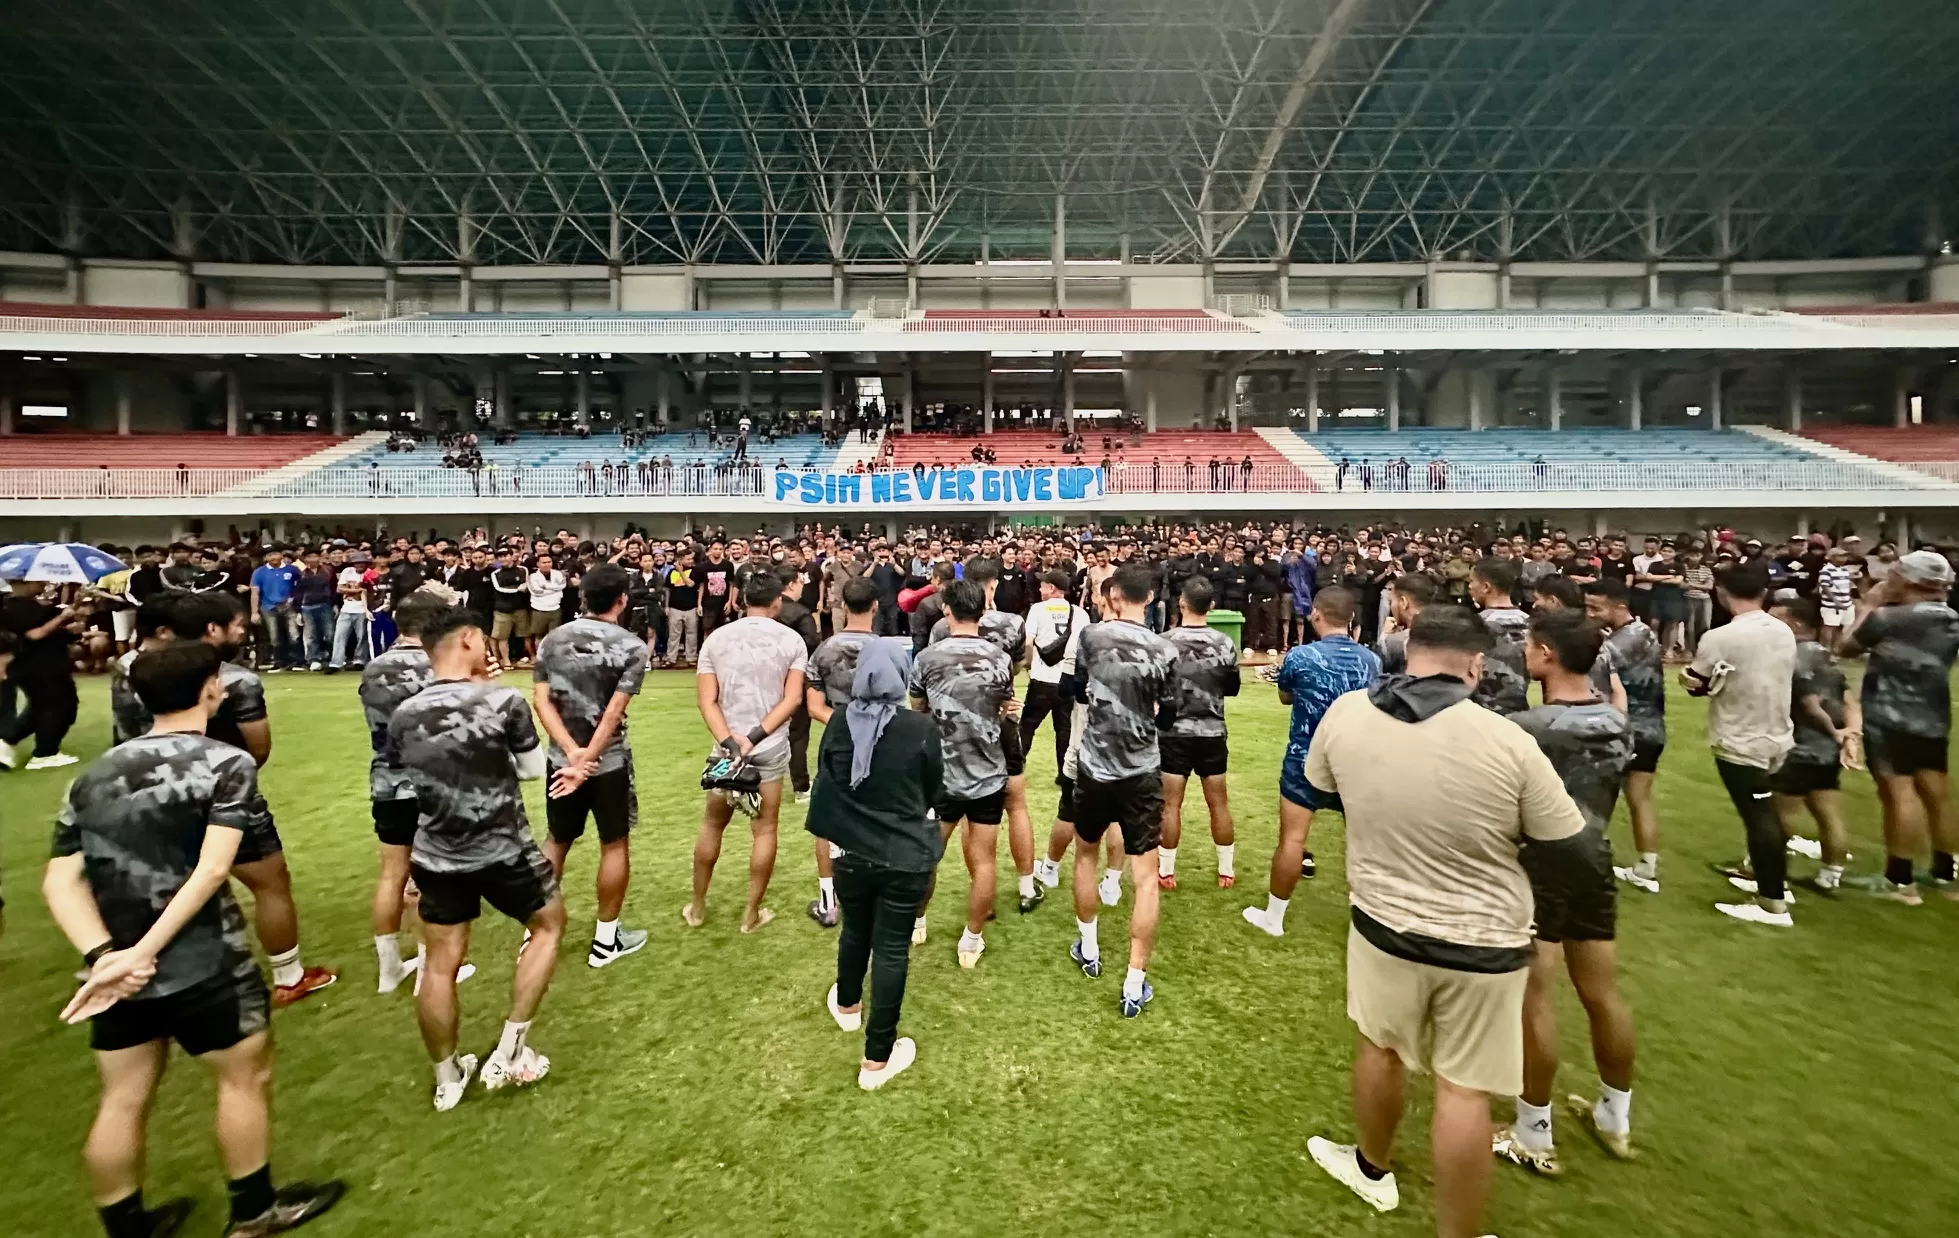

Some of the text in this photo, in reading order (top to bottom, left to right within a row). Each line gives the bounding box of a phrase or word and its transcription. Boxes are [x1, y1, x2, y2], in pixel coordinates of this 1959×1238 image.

[776, 467, 1104, 504] PSIM NEVER GIVE UP!
